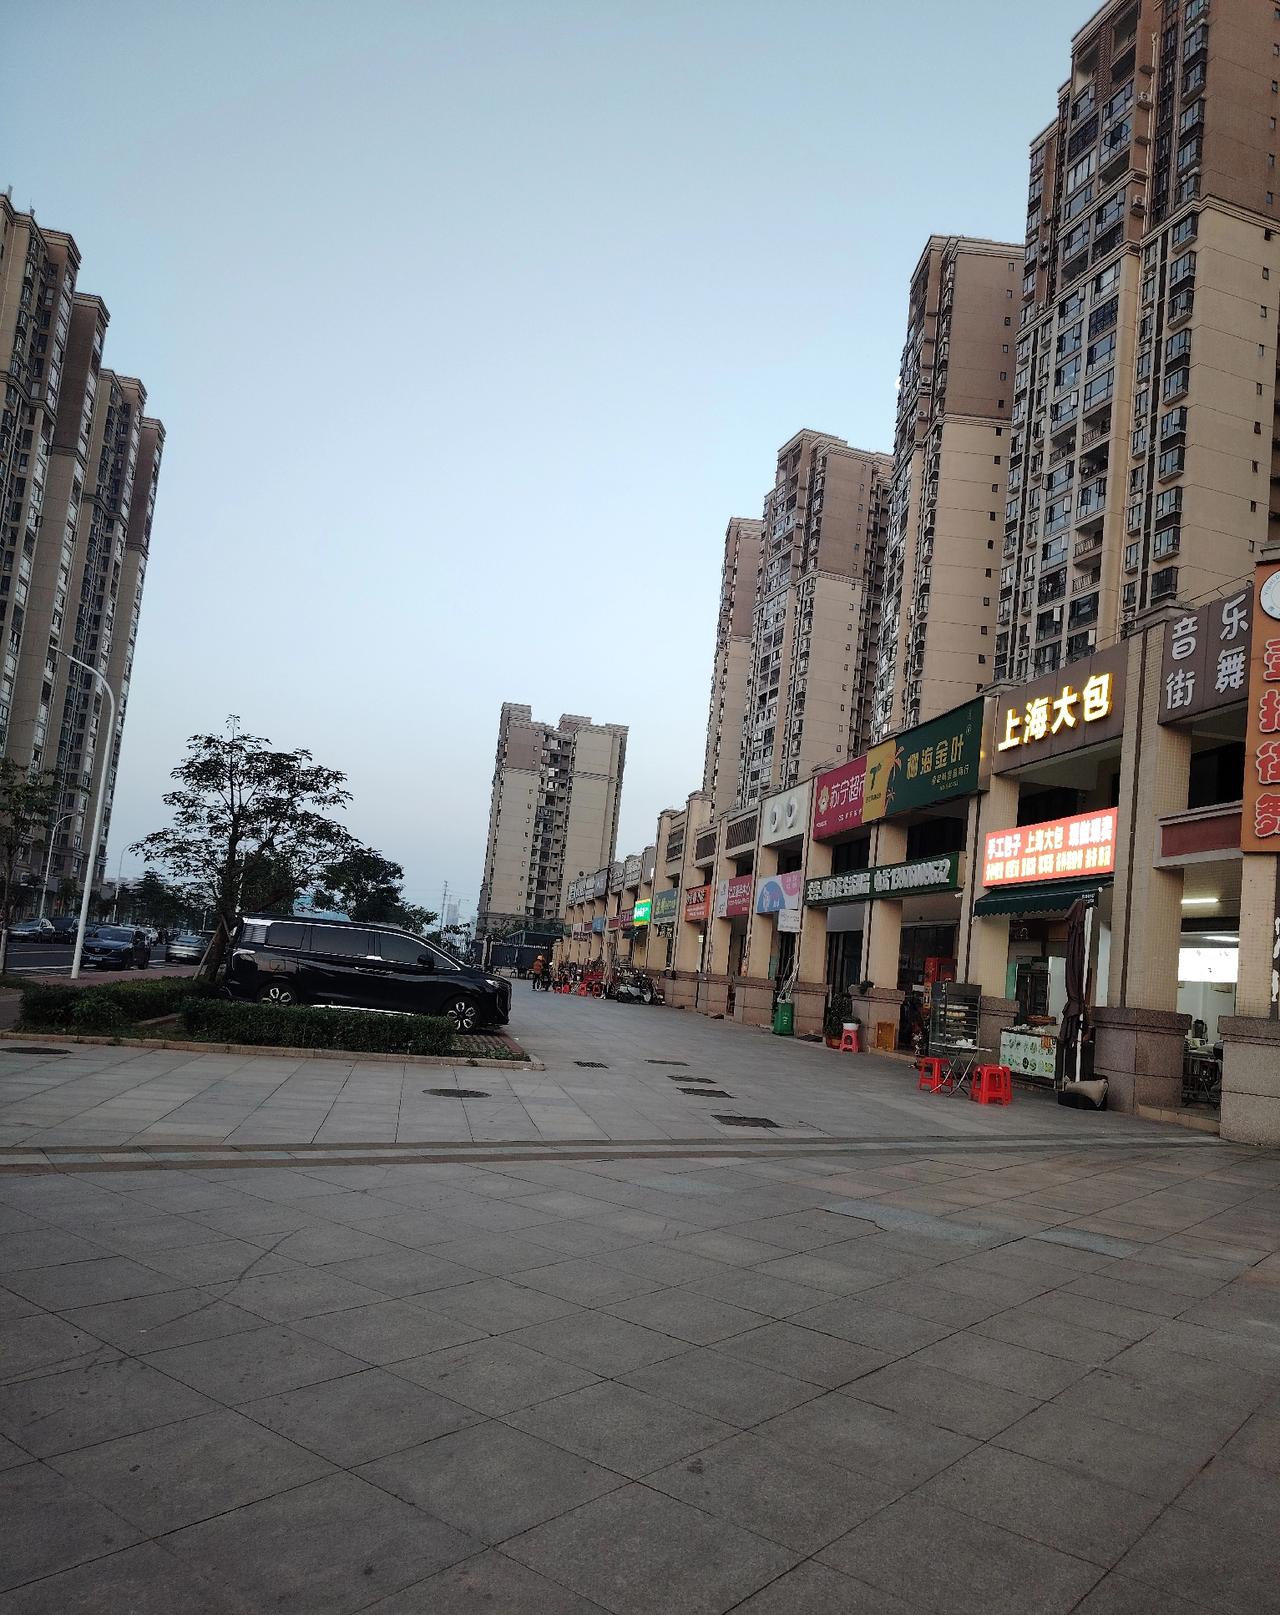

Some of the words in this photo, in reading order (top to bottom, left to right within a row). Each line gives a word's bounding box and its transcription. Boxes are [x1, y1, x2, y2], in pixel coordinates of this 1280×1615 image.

[998, 673, 1111, 751] 上海大包
[1024, 826, 1064, 853] 上海大包
